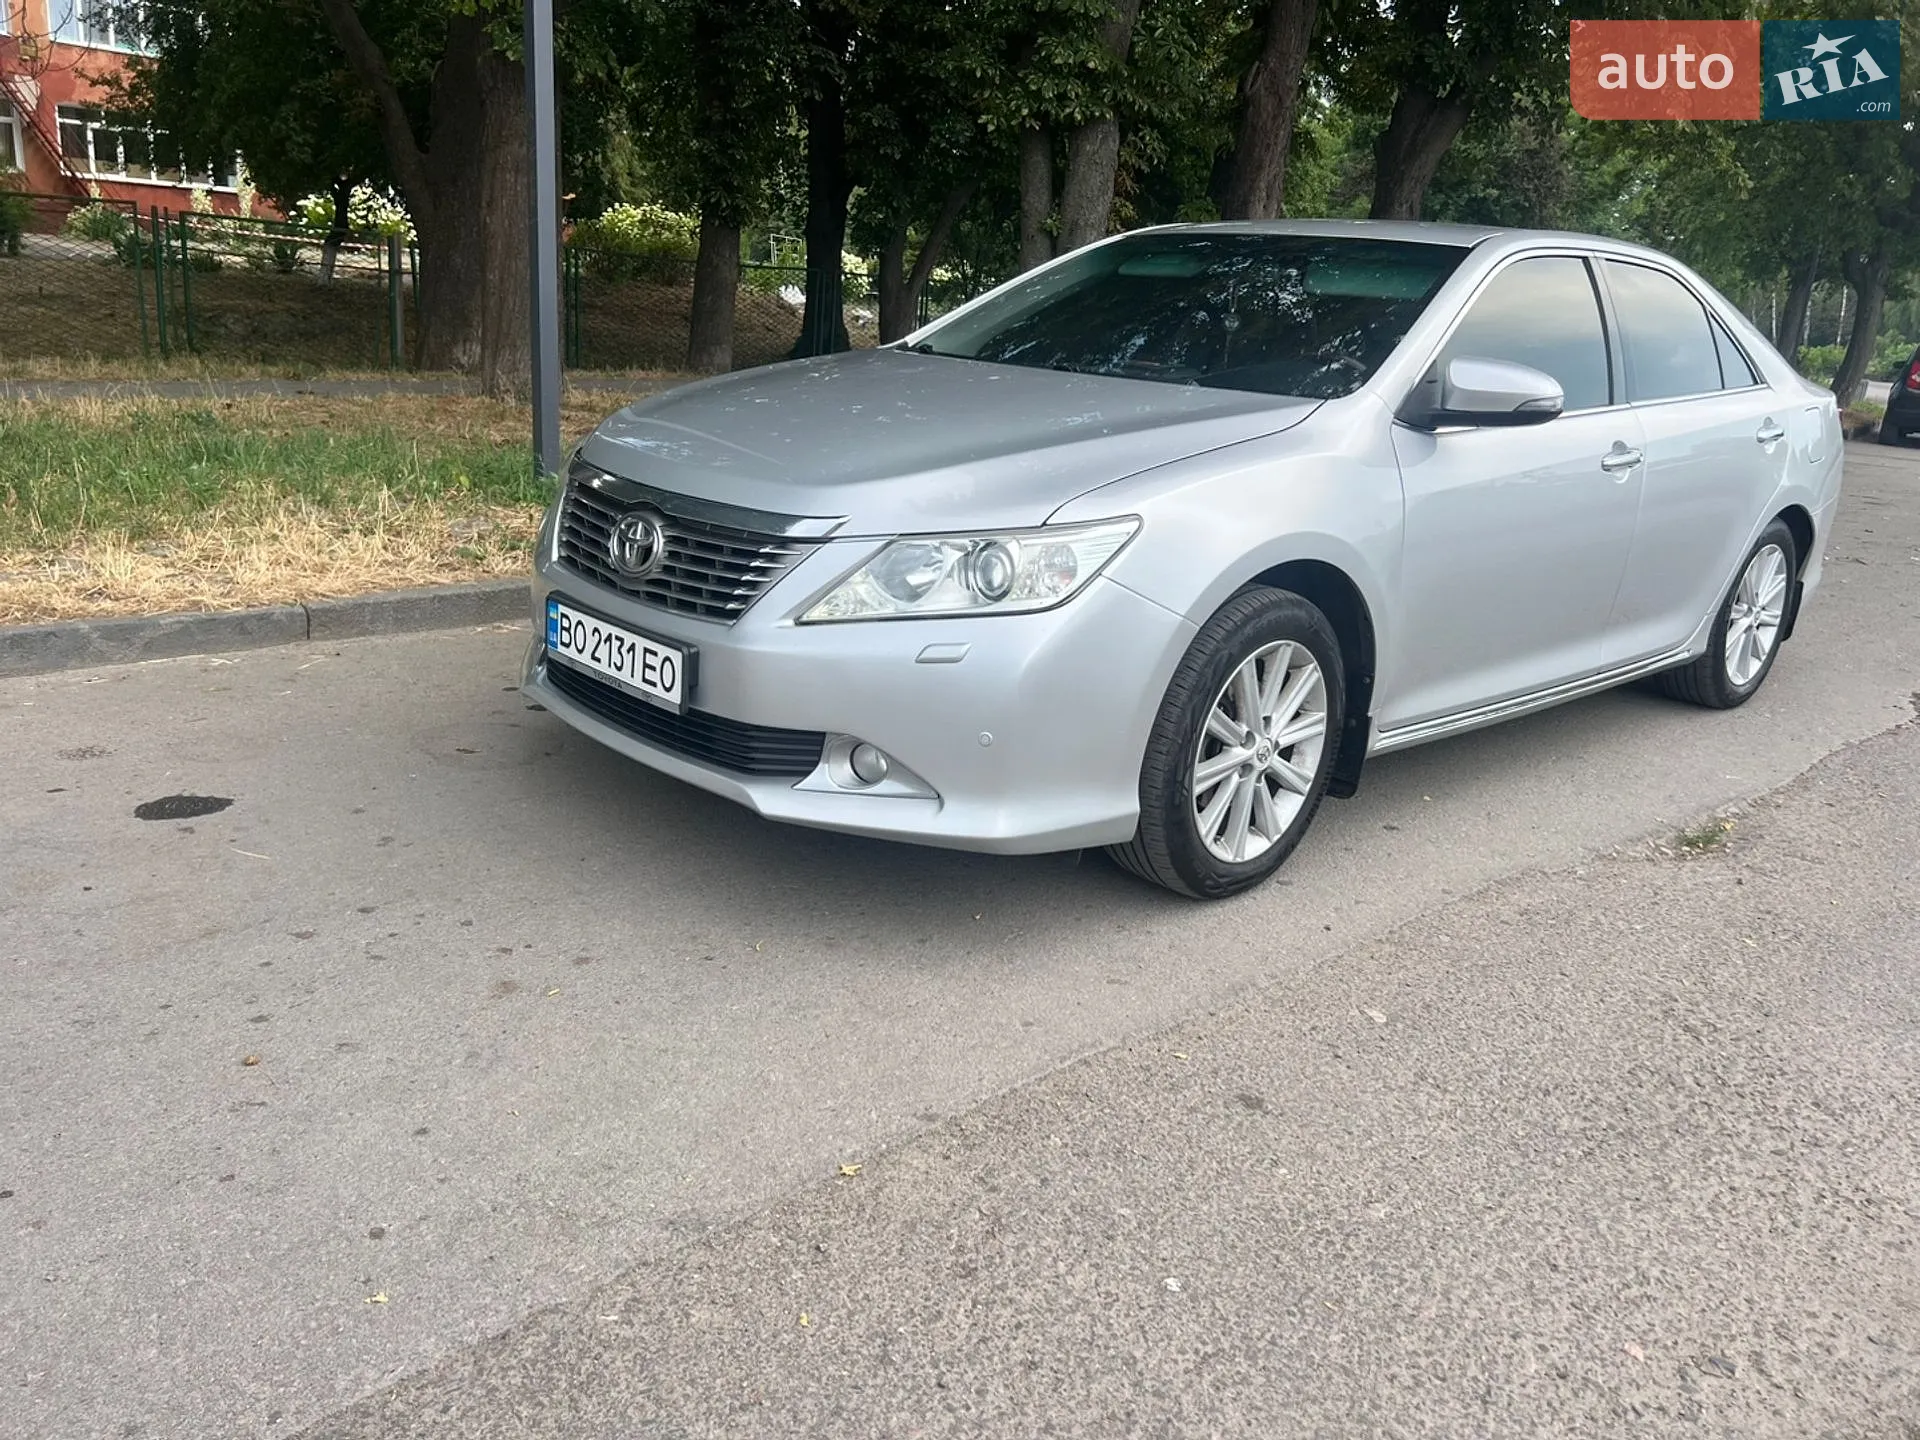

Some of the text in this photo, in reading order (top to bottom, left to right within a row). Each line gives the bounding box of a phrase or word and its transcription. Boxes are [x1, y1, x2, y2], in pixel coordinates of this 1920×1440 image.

[560, 612, 676, 693] BO 2131 EO
